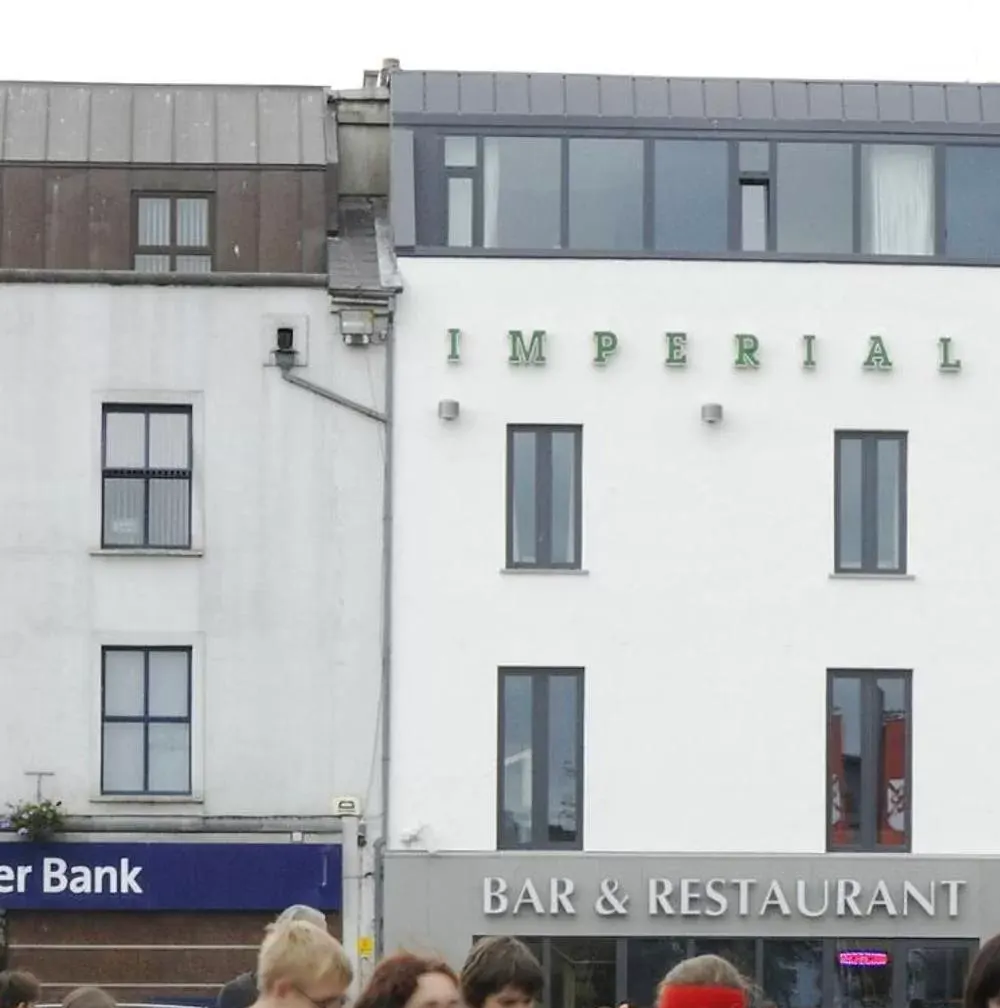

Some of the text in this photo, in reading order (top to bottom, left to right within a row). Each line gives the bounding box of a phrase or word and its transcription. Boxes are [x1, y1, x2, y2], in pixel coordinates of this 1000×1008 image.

[446, 327, 962, 375] IMPERIAL
[42, 857, 144, 894] Bank
[482, 876, 967, 918] BAR & RESTAURANT
